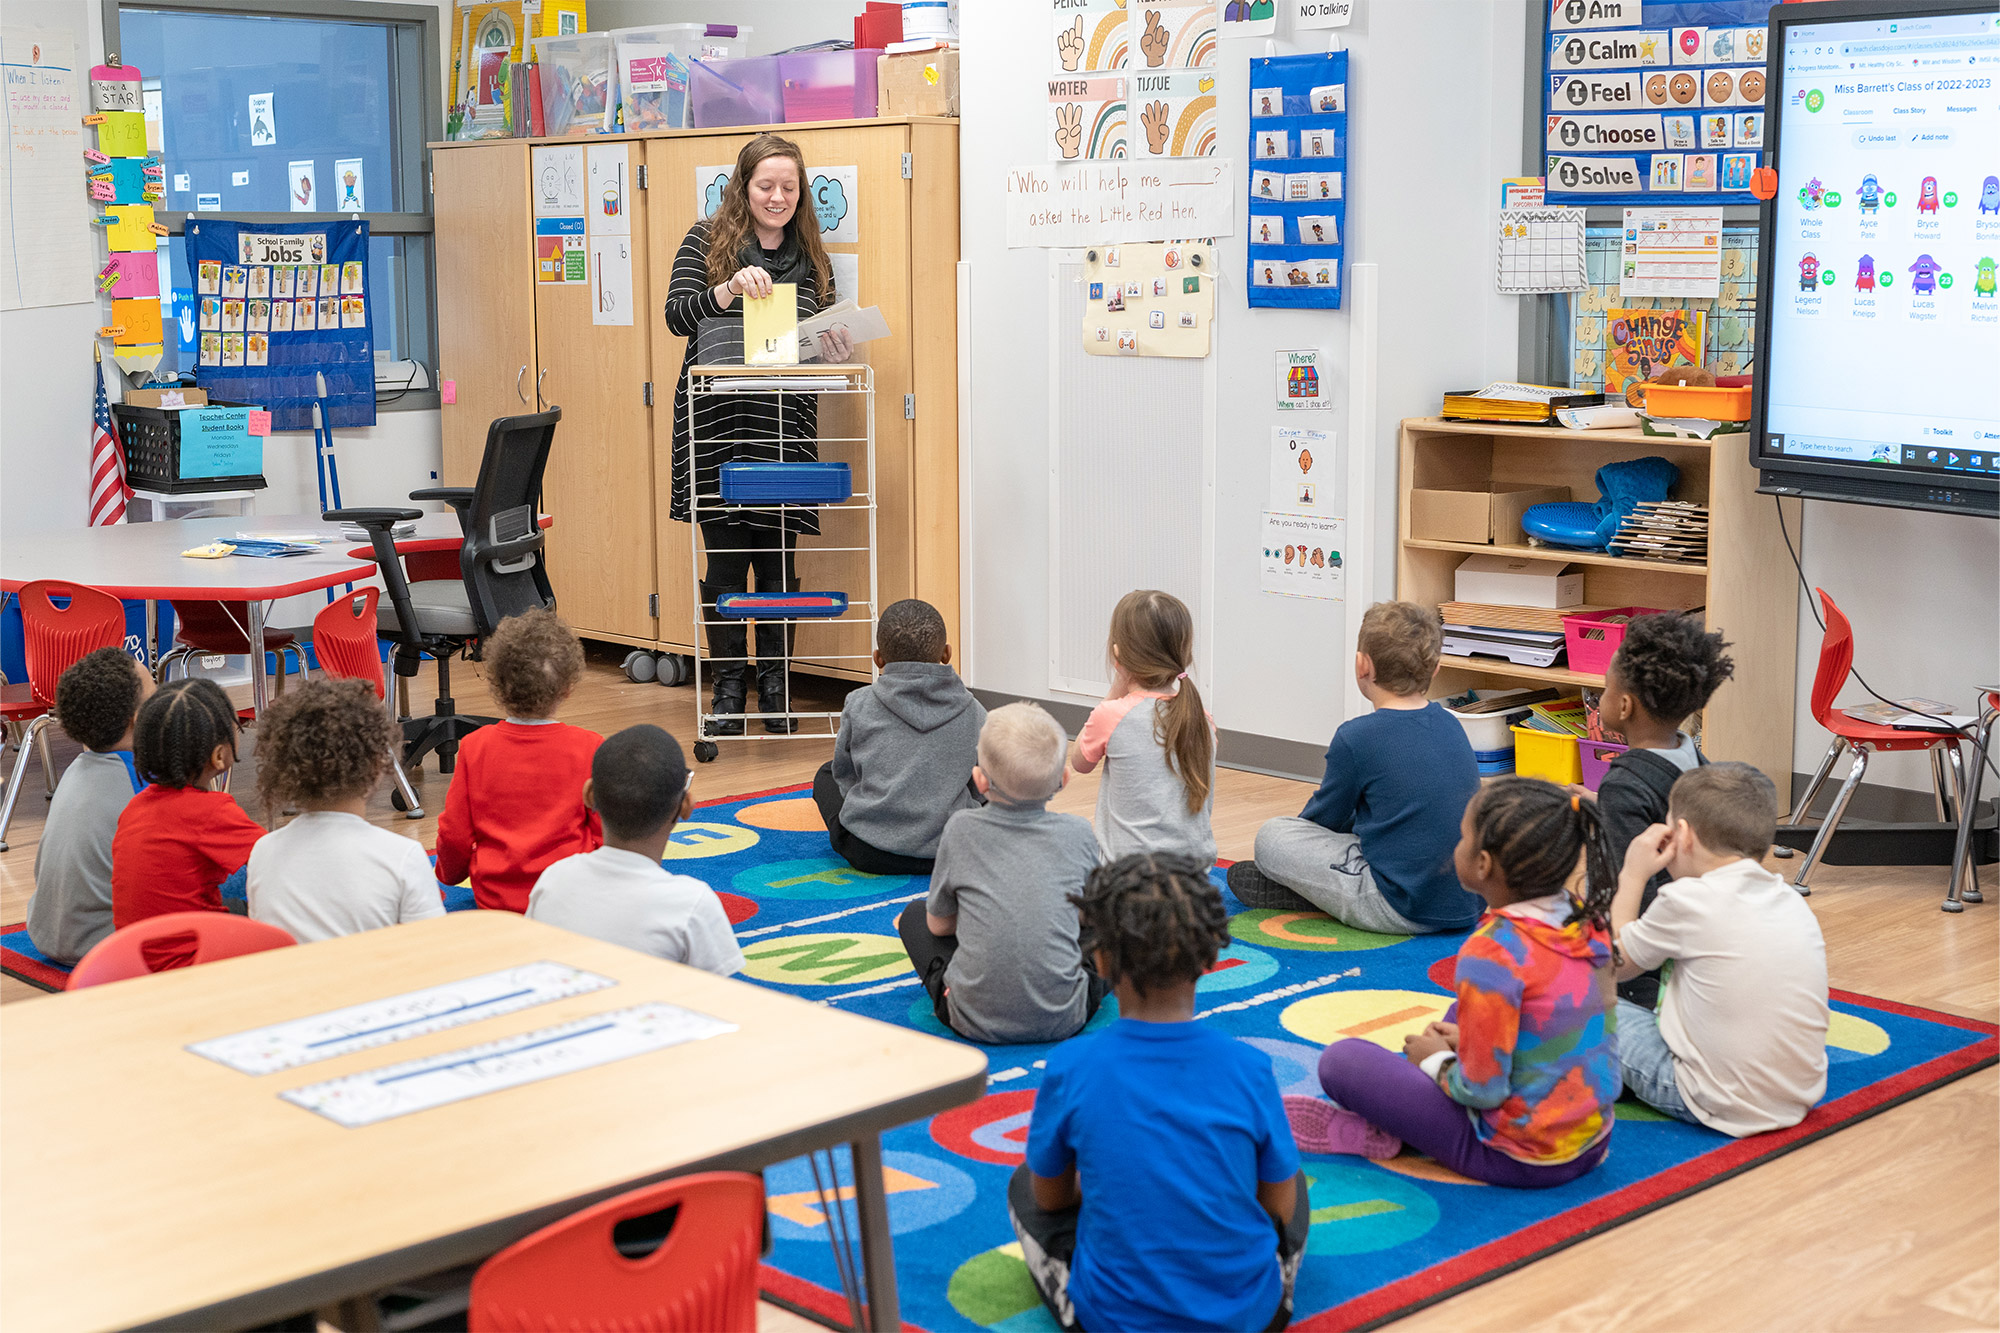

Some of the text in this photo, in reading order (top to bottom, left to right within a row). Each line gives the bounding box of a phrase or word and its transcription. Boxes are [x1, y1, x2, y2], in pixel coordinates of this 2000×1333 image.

[1300, 3, 1349, 17] NO Talking
[1589, 3, 1622, 19] Am
[1554, 37, 1560, 46] 2
[1589, 41, 1637, 60] Calm
[30, 72, 36, 84] I
[1554, 78, 1560, 87] 3
[1048, 80, 1088, 96] WATER
[1137, 76, 1171, 92] TISSUE
[1835, 78, 1991, 94] Miss Barrett's Class of 2022-2023
[1591, 82, 1631, 101] Feel
[103, 90, 139, 105] STAR!
[1911, 107, 1926, 115] Story
[1947, 106, 1977, 114] Messages
[1549, 118, 1555, 127] 4
[1583, 124, 1656, 144] Choose
[1885, 134, 1897, 142] last
[1921, 133, 1949, 141] Add note
[1549, 158, 1555, 168] 5
[1581, 167, 1634, 185] Solve
[1061, 169, 1088, 191] will
[1098, 166, 1129, 200] help
[1141, 174, 1162, 188] me
[818, 186, 828, 205] C
[1826, 194, 1840, 203] 544
[1887, 195, 1895, 204] 41
[1945, 195, 1956, 204] 30
[1029, 201, 1197, 226] asked the Little Red Hen.
[1800, 218, 1823, 227] Whole
[1859, 219, 1878, 229] Ayce
[1917, 219, 1939, 230] Bryce
[1801, 229, 1821, 239] Class
[1861, 231, 1876, 239] Pate
[1914, 231, 1941, 240] Howard
[257, 237, 304, 247] School Family
[1728, 238, 1744, 246] Friday
[260, 246, 303, 263] Jobs
[1728, 259, 1735, 270] 3
[1824, 273, 1834, 282] 35
[1881, 275, 1891, 283] 39
[1941, 276, 1952, 285] 23
[1588, 295, 1594, 304] 5
[1725, 293, 1734, 301] 10
[1795, 296, 1822, 305] Legend
[1854, 297, 1875, 307] Lucas
[1913, 299, 1935, 309] Lucas
[1972, 301, 1998, 310] Melvin
[1796, 307, 1819, 316] Nelson
[1909, 311, 1937, 321] Wagster
[1971, 314, 1998, 322] Richard
[1583, 326, 1592, 336] 12
[1288, 353, 1316, 364] Where?
[1724, 361, 1735, 372] 24
[1933, 427, 1953, 436] Toolkit
[1800, 442, 1812, 450] Type
